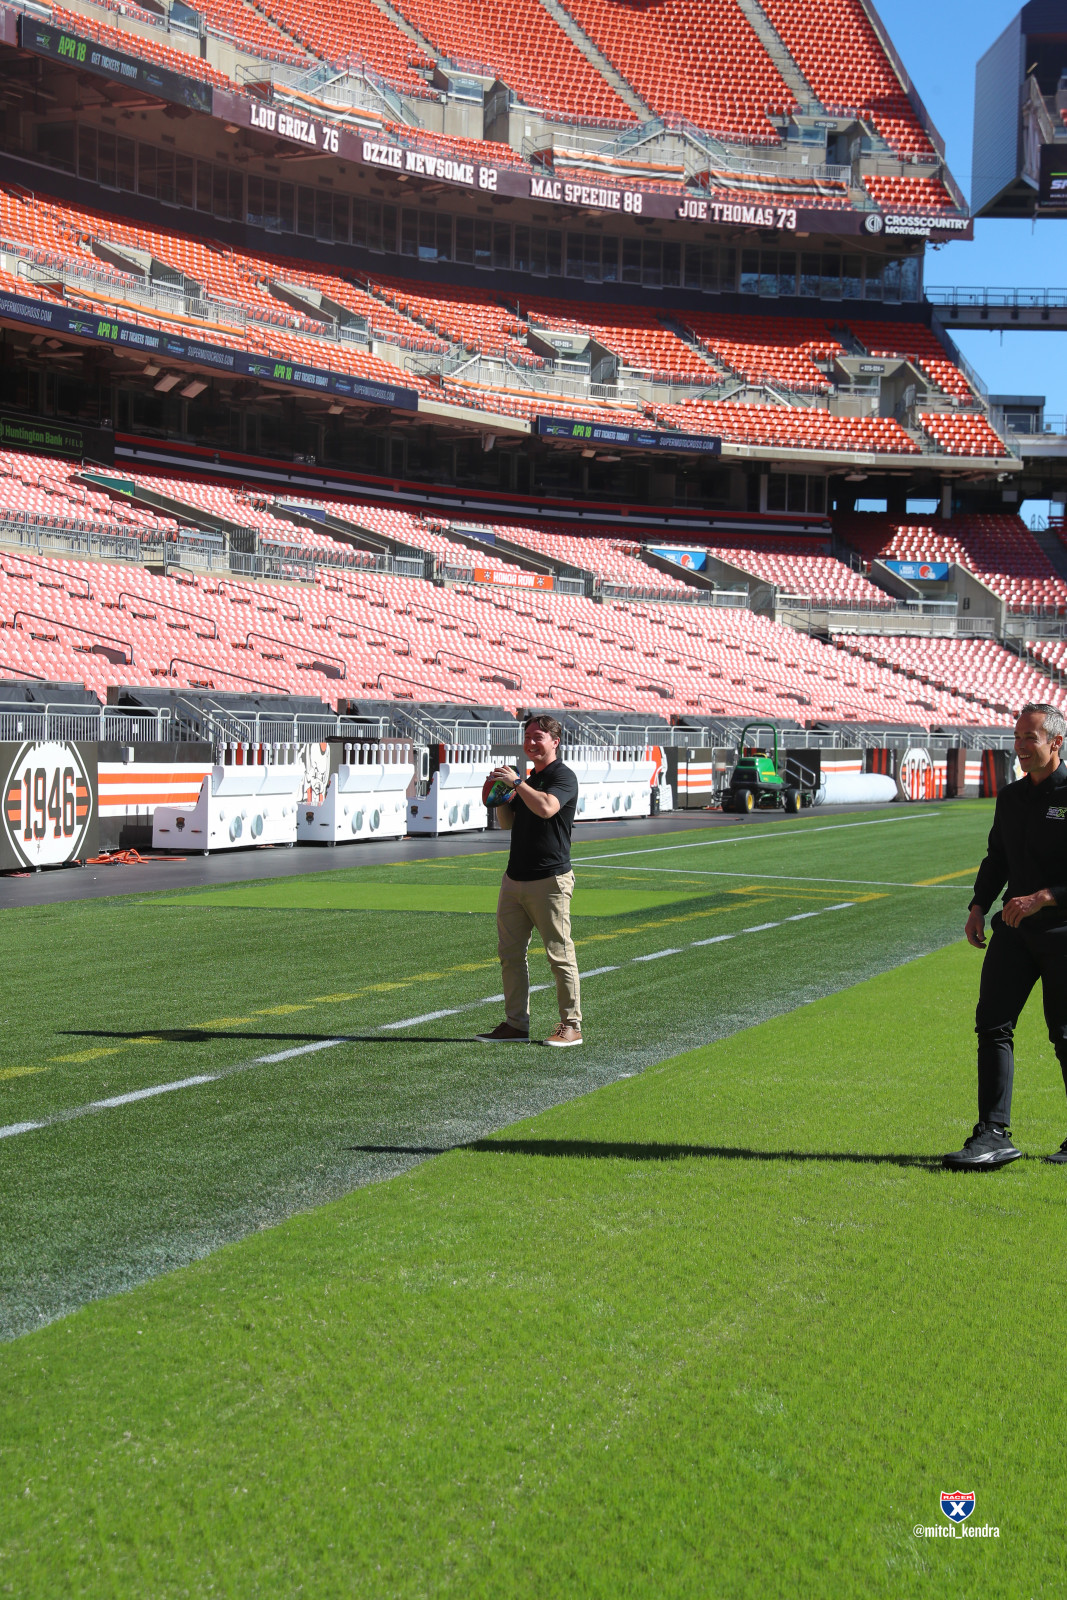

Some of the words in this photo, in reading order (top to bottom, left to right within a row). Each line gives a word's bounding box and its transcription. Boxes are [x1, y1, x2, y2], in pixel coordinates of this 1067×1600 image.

[58, 35, 76, 59] APR
[76, 41, 87, 62] 18
[91, 51, 101, 66] GET
[101, 53, 120, 73] TICKETS
[120, 62, 138, 79] TODAY!
[250, 104, 277, 131] LOU
[277, 113, 317, 145] GROZA
[322, 126, 339, 153] 76
[362, 141, 402, 168] OZZIE
[405, 150, 475, 185] NEWSOME
[478, 166, 498, 191] 82
[530, 178, 562, 200] MAC
[564, 183, 621, 210] SPEEDIE
[623, 191, 643, 214] 88
[678, 200, 707, 219] JOE
[711, 202, 774, 226] THOMAS
[776, 208, 797, 229] 73
[884, 215, 970, 230] CROSSCOUNTRY
[885, 226, 931, 236] MORTGAGE
[97, 321, 111, 338] APR
[111, 324, 119, 340] 18
[120, 329, 129, 341] GET
[273, 364, 286, 379] APR
[286, 366, 293, 381] 18
[5, 424, 45, 443] Huntington
[45, 432, 63, 447] Bank
[64, 437, 84, 448] FIELD
[572, 424, 585, 437] APR
[585, 425, 592, 438] 18
[492, 571, 518, 585] HONOR
[517, 574, 536, 587] ROW
[23, 766, 75, 841] 1946
